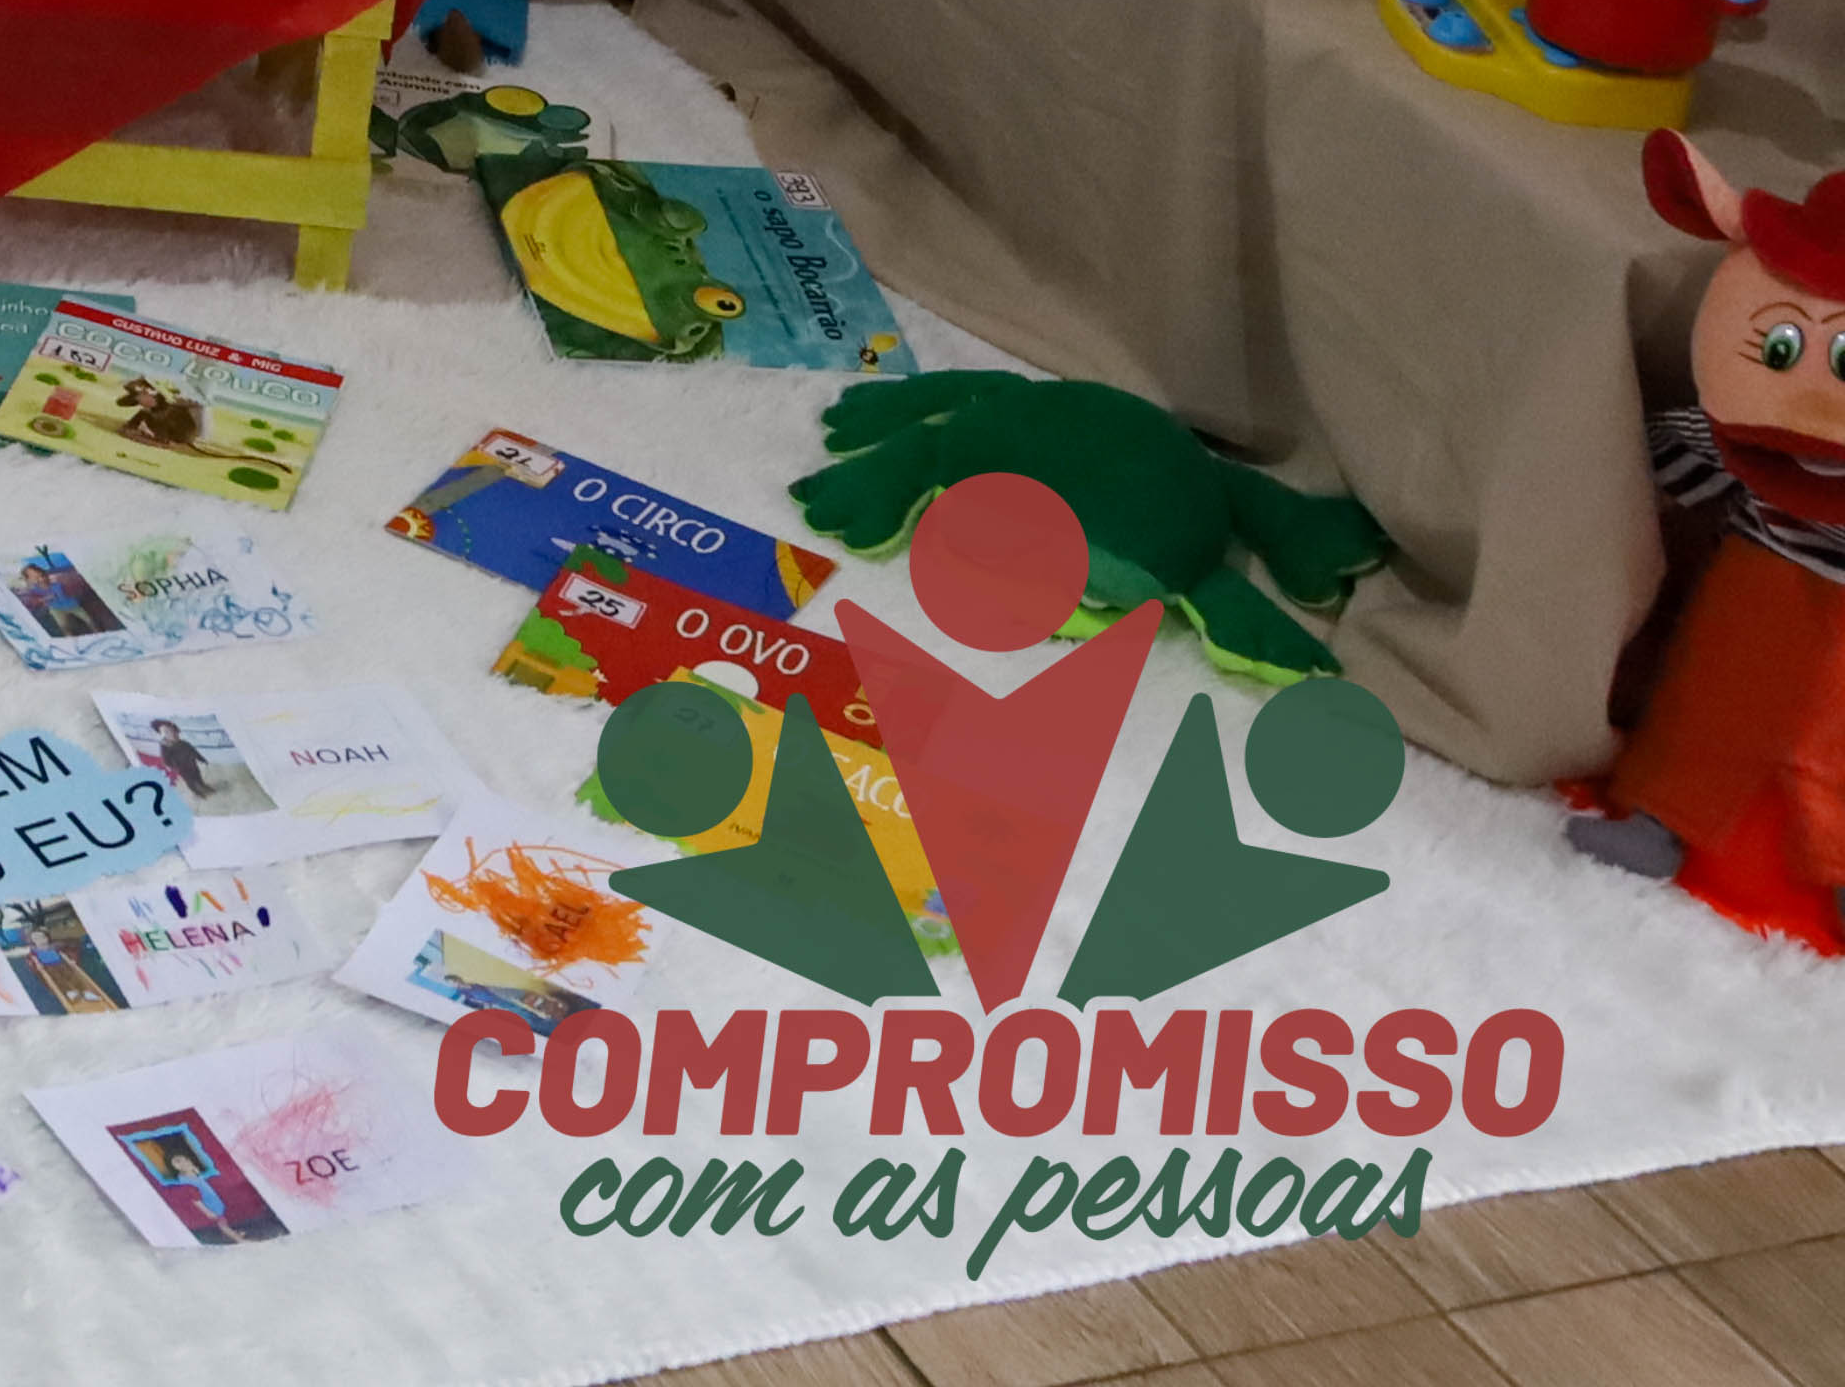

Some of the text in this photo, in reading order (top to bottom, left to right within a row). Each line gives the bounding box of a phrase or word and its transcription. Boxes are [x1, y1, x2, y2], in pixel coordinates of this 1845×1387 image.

[762, 206, 804, 249] sapo
[786, 255, 846, 340] Bocarrão
[112, 317, 282, 373] GUSTAVO LUIZ & MIG
[573, 476, 727, 555] O CIRCO
[116, 566, 228, 604] SOPHIA
[578, 590, 626, 617] 25
[676, 608, 811, 677] O OVO
[289, 744, 389, 767] NOAH
[15, 780, 174, 869] EU?
[119, 919, 256, 955] HELENA
[285, 1149, 361, 1187] ZOE
